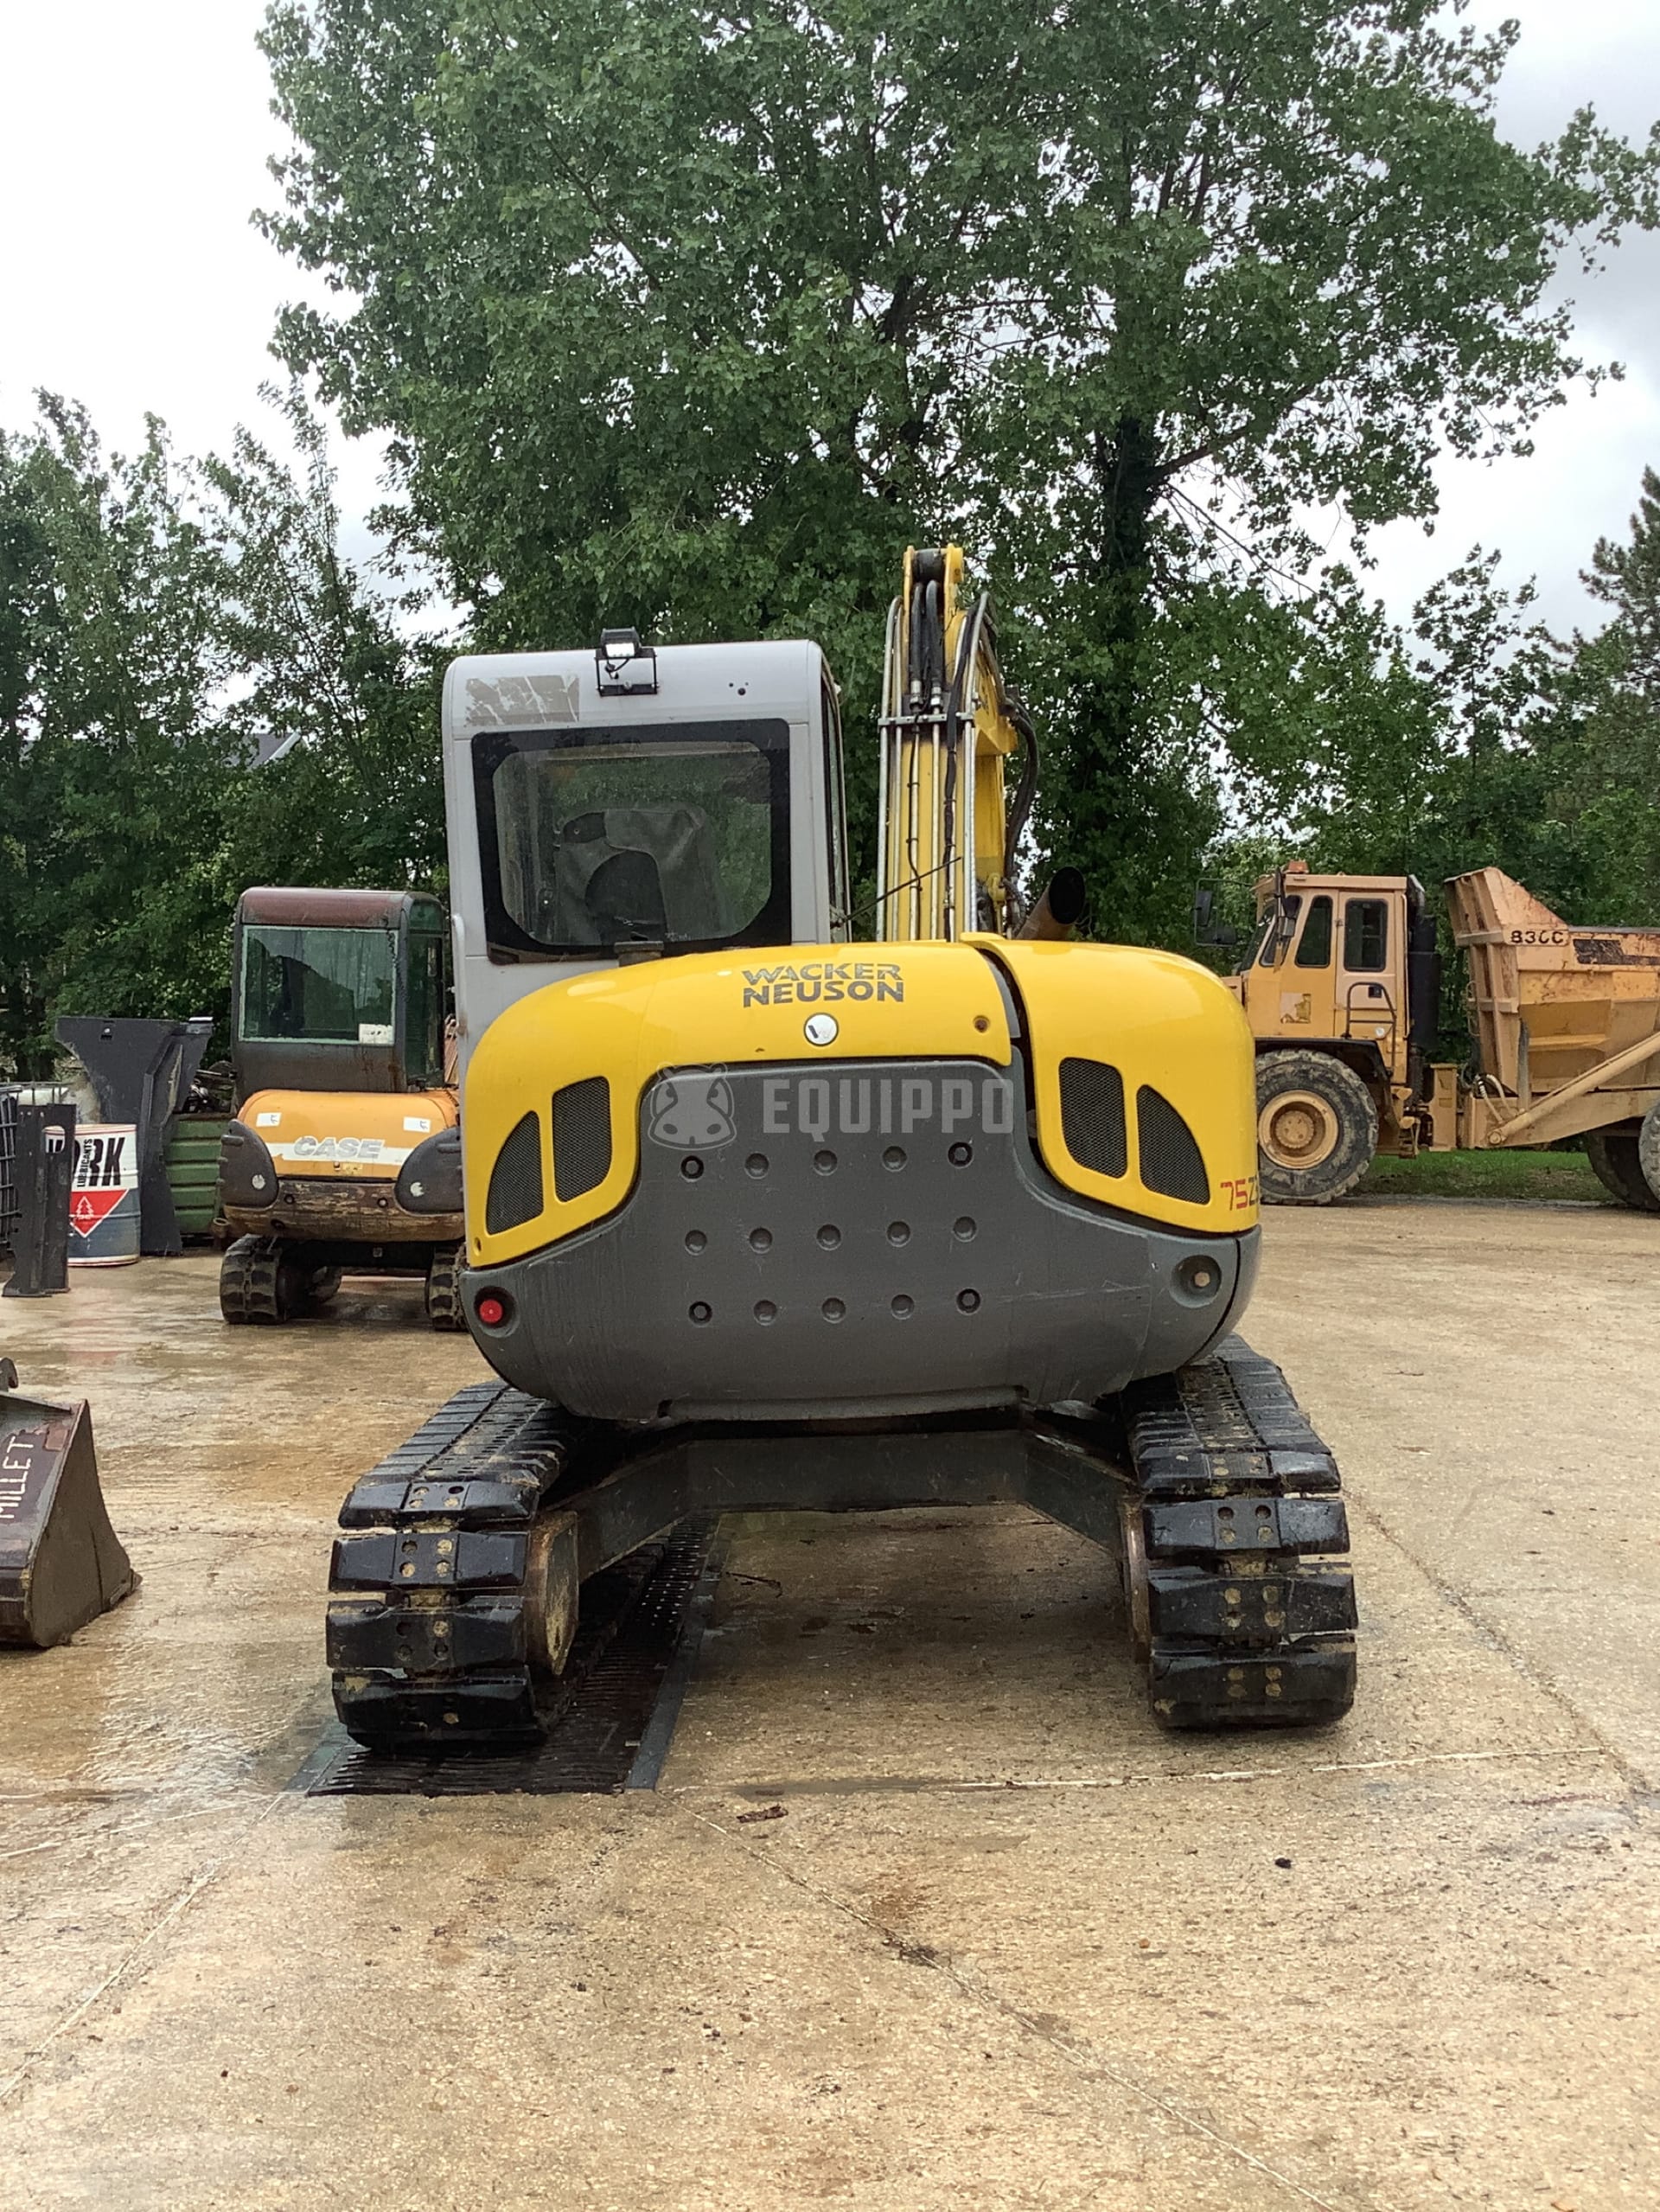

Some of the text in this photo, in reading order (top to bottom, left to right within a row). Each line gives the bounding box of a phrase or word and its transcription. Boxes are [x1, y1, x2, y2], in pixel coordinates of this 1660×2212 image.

[742, 962, 903, 986] WACKER
[743, 980, 904, 1008] NEUSON
[293, 1136, 386, 1160] CASE
[1220, 1174, 1258, 1211] 75Z
